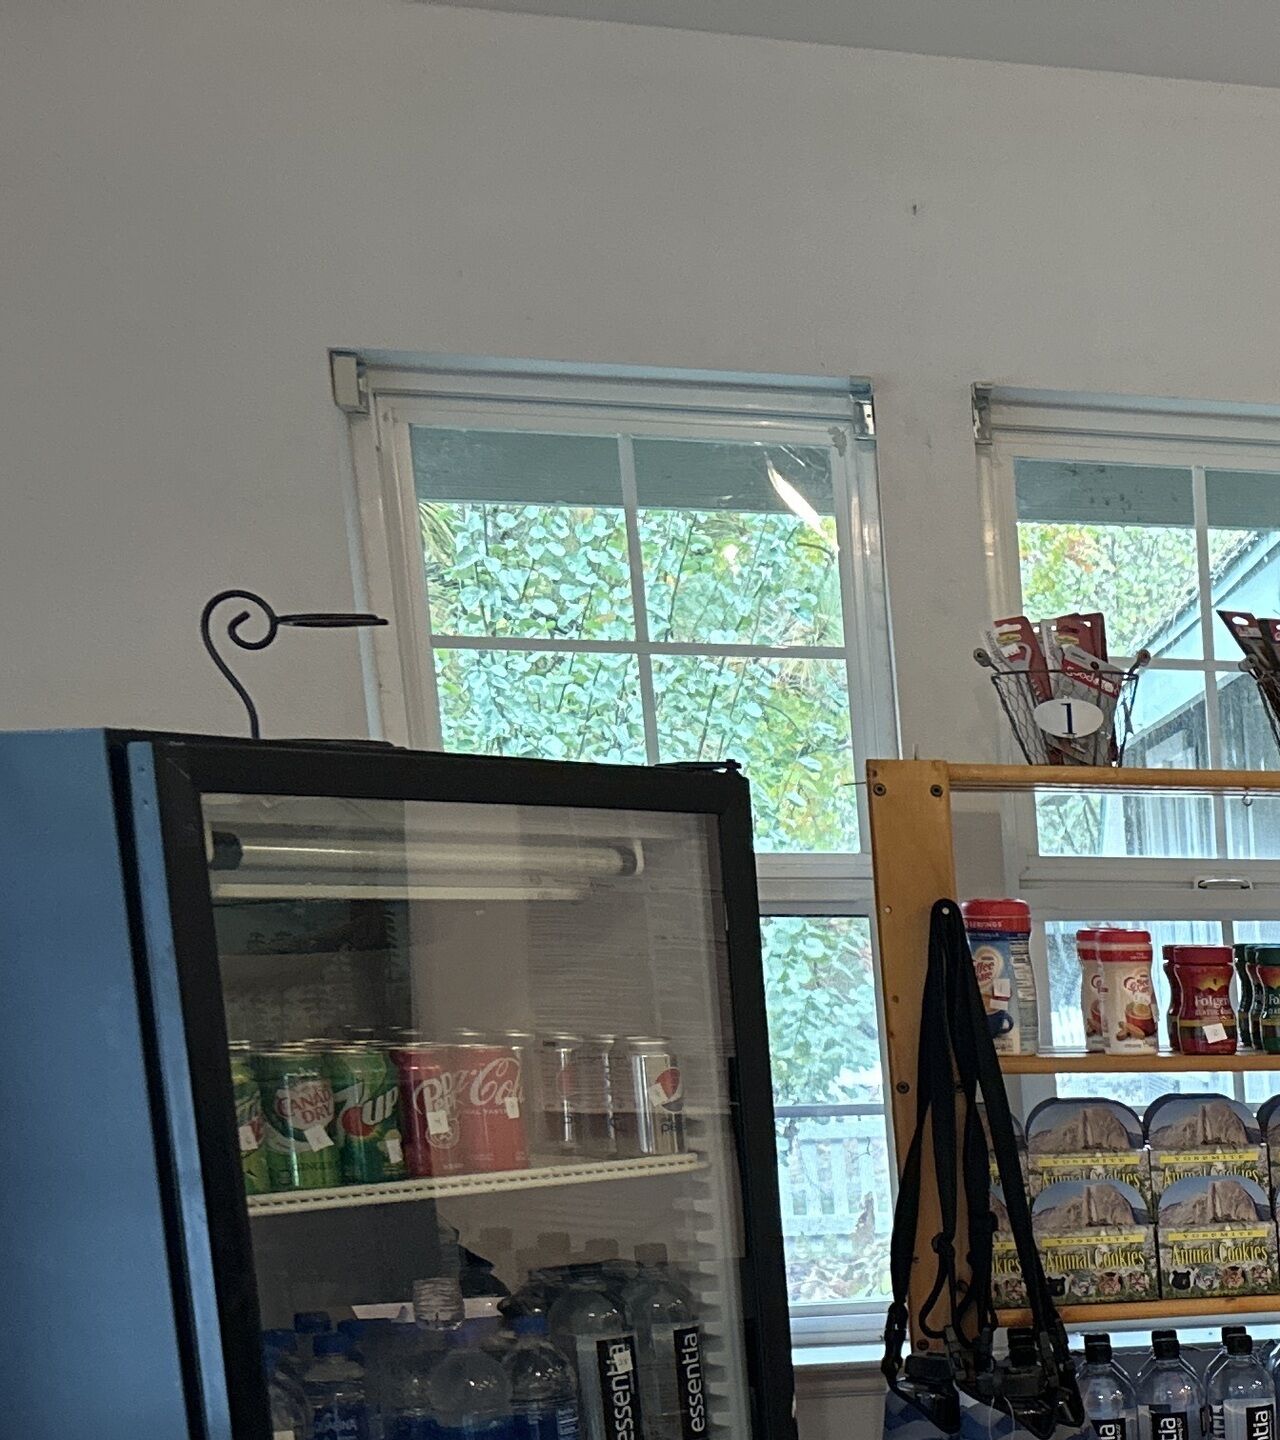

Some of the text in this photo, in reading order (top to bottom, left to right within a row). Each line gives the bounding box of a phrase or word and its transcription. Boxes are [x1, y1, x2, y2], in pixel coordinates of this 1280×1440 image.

[1061, 703, 1074, 736] 1
[1057, 1236, 1130, 1244] YOSEMITE
[1182, 1231, 1253, 1239] YOSEMITE
[1046, 1249, 1146, 1273] Animal Cookies
[1172, 1244, 1268, 1267] Animal Cookies
[681, 1332, 706, 1433] essentia
